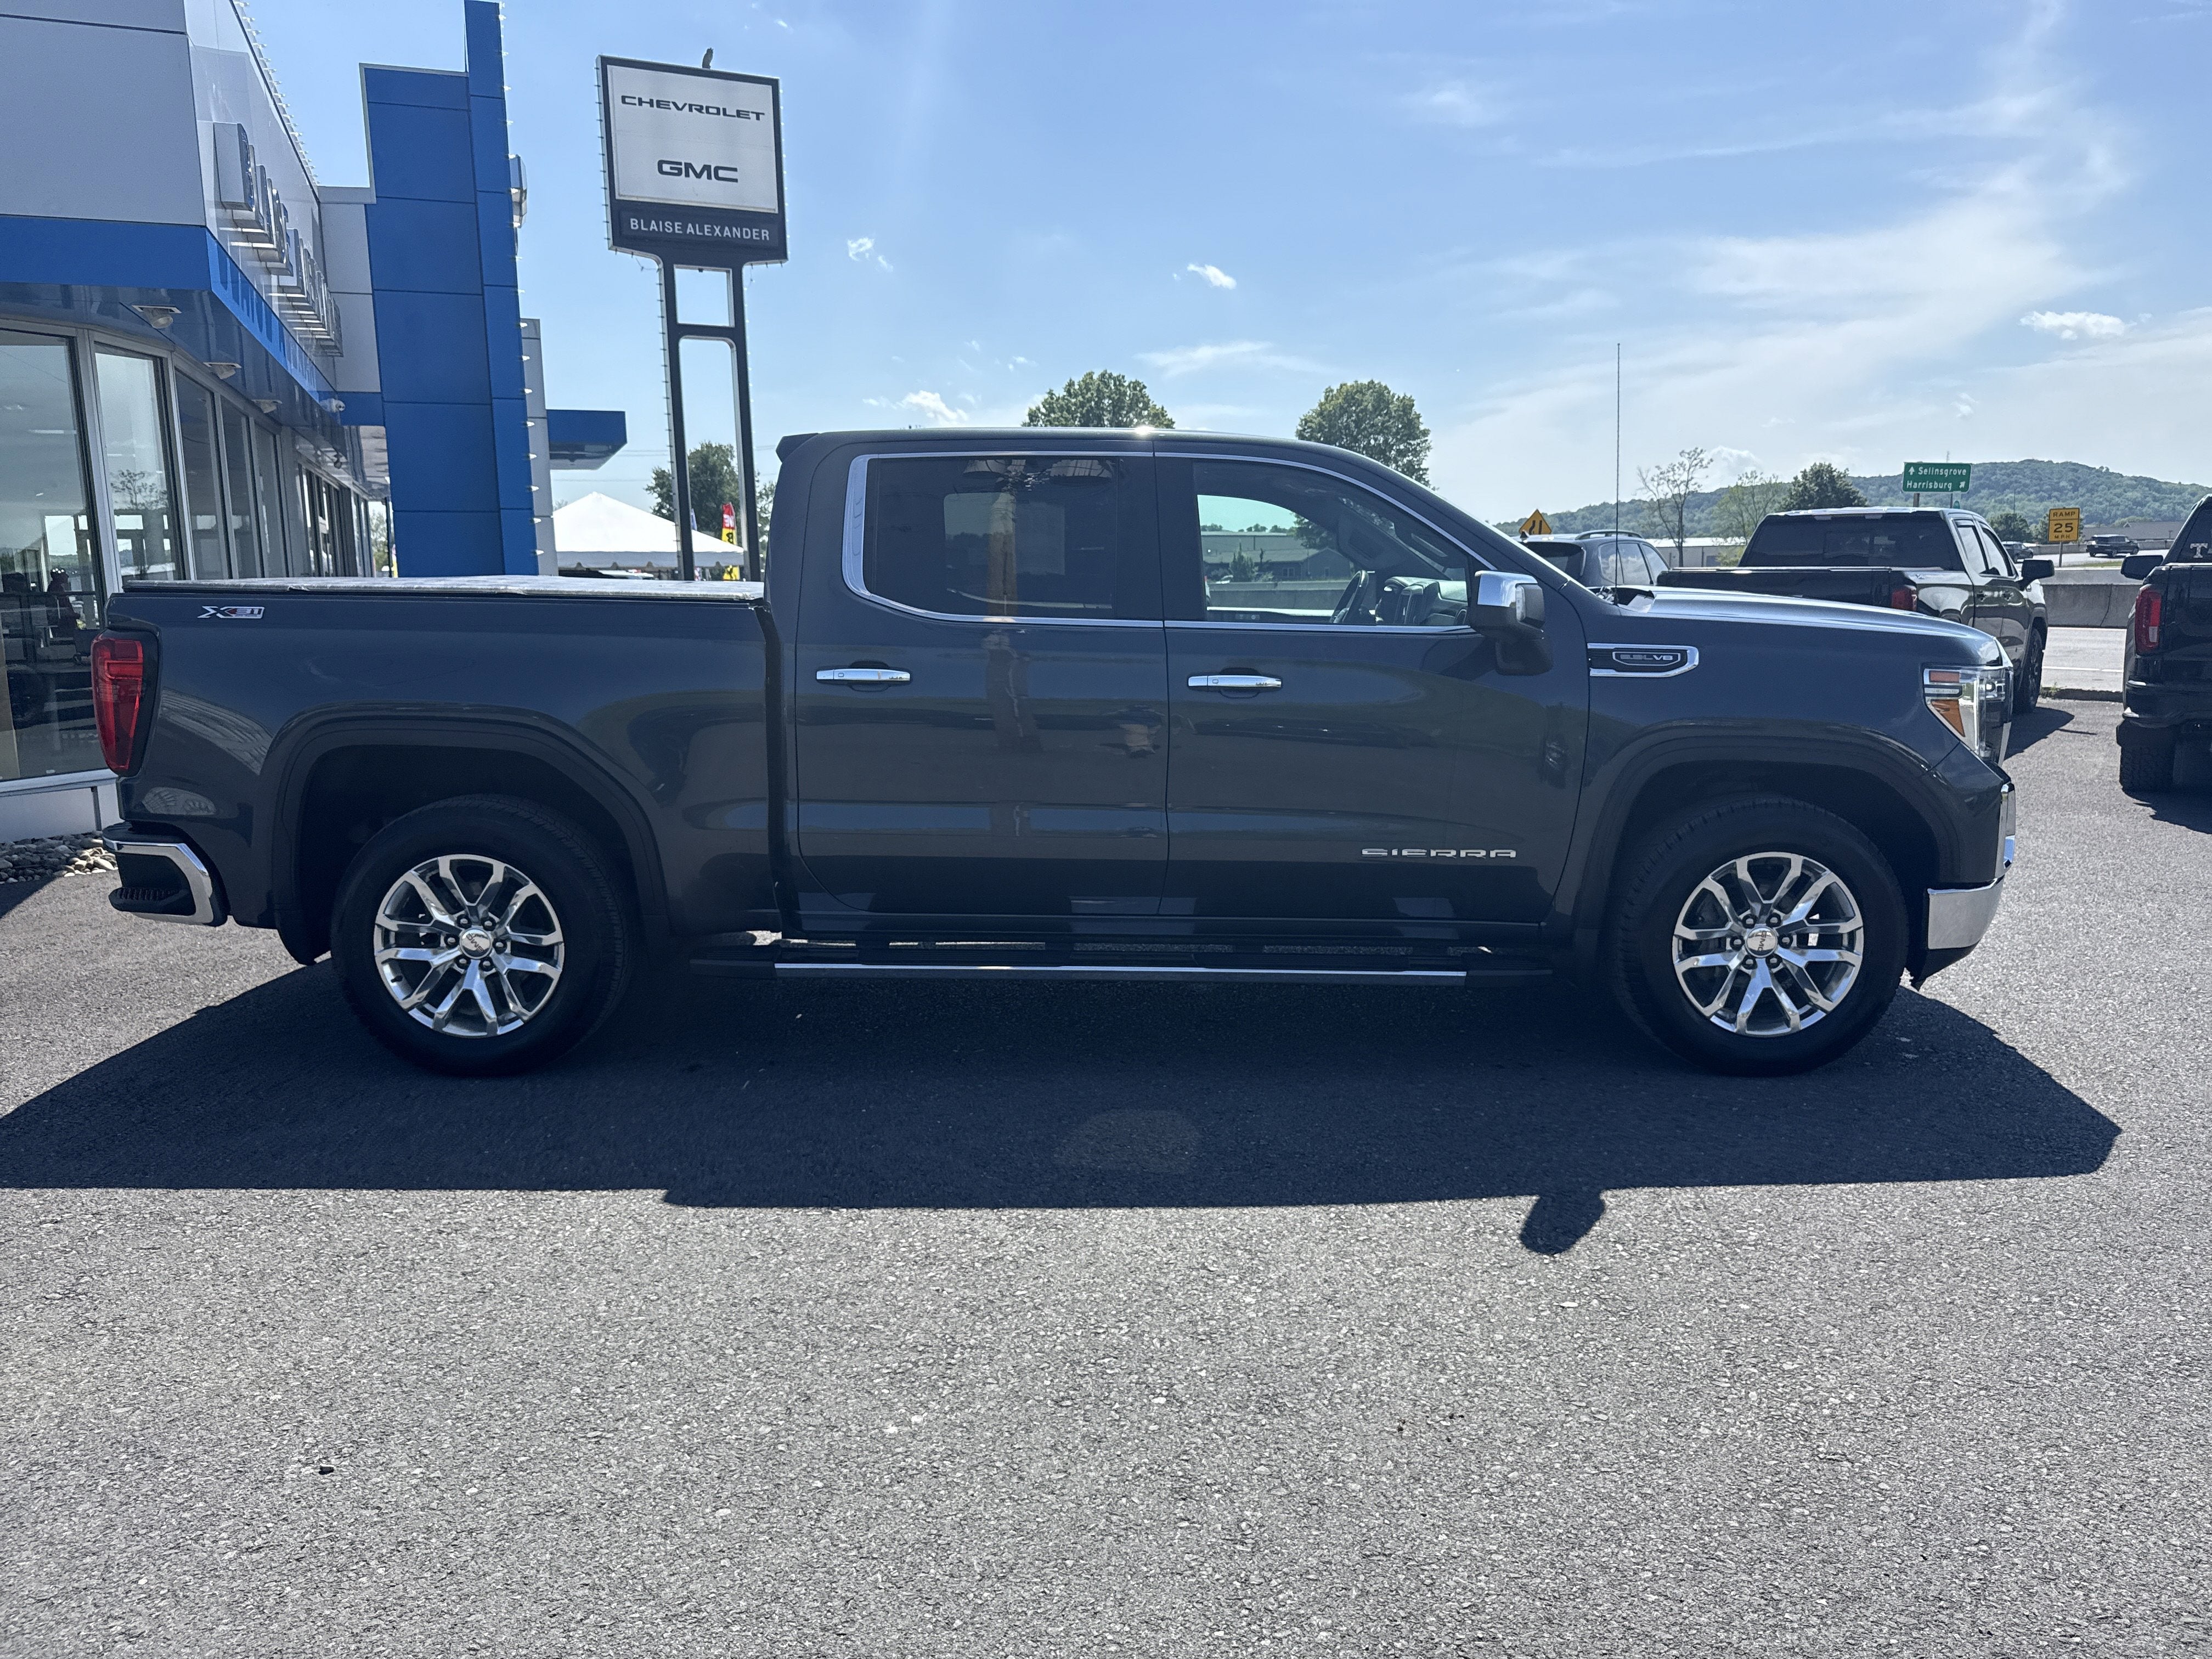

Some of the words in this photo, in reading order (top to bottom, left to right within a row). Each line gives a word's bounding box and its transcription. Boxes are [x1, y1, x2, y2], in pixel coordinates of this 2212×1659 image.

[621, 95, 765, 121] CHEVROLET
[657, 159, 738, 183] GMC
[630, 218, 683, 234] BLAISE
[686, 223, 770, 240] ALEXANDER
[1918, 466, 1967, 478] Selinsgrove
[1906, 480, 1952, 492] Harrisburg
[2053, 522, 2073, 533] 25
[1362, 848, 1516, 859] SIERRA
